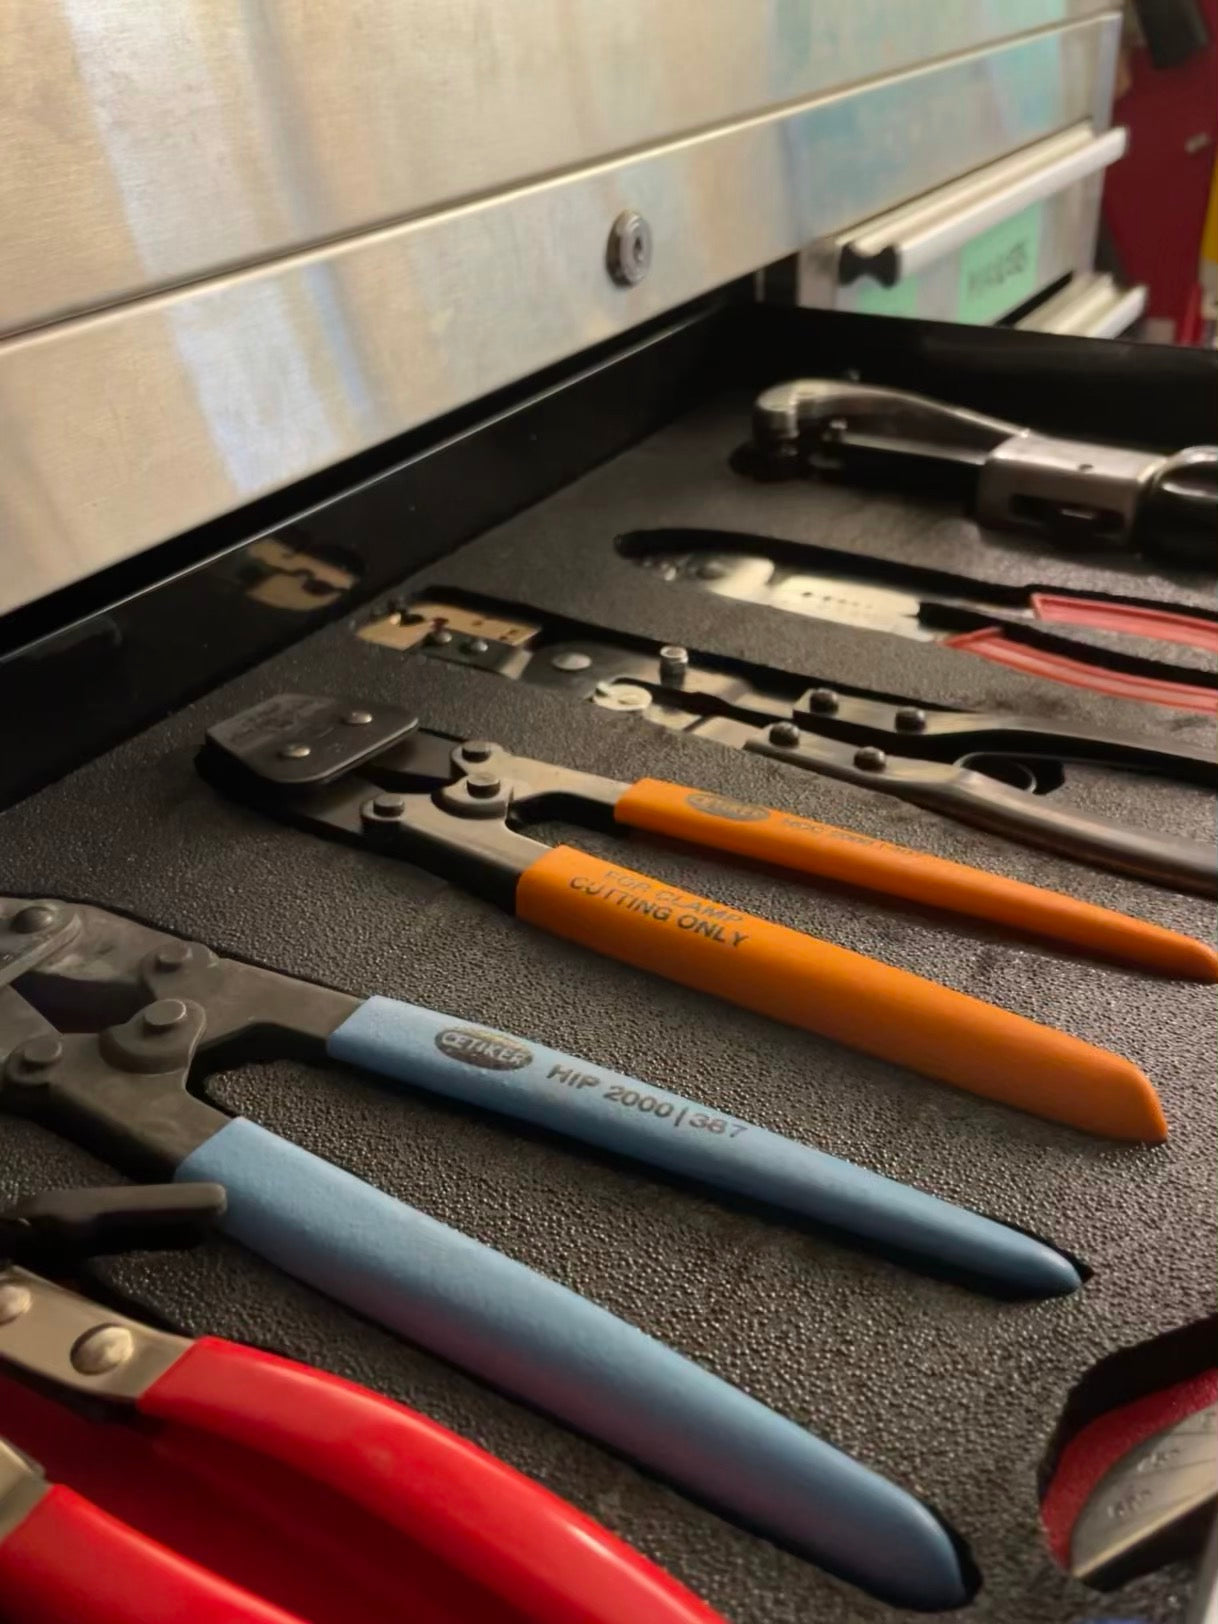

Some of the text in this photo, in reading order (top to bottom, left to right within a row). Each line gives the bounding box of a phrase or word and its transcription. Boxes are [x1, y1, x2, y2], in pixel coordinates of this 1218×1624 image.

[569, 876, 749, 948] CUTTING ONLY
[604, 870, 744, 923] FOR CLAMP
[546, 1063, 601, 1090] HIP
